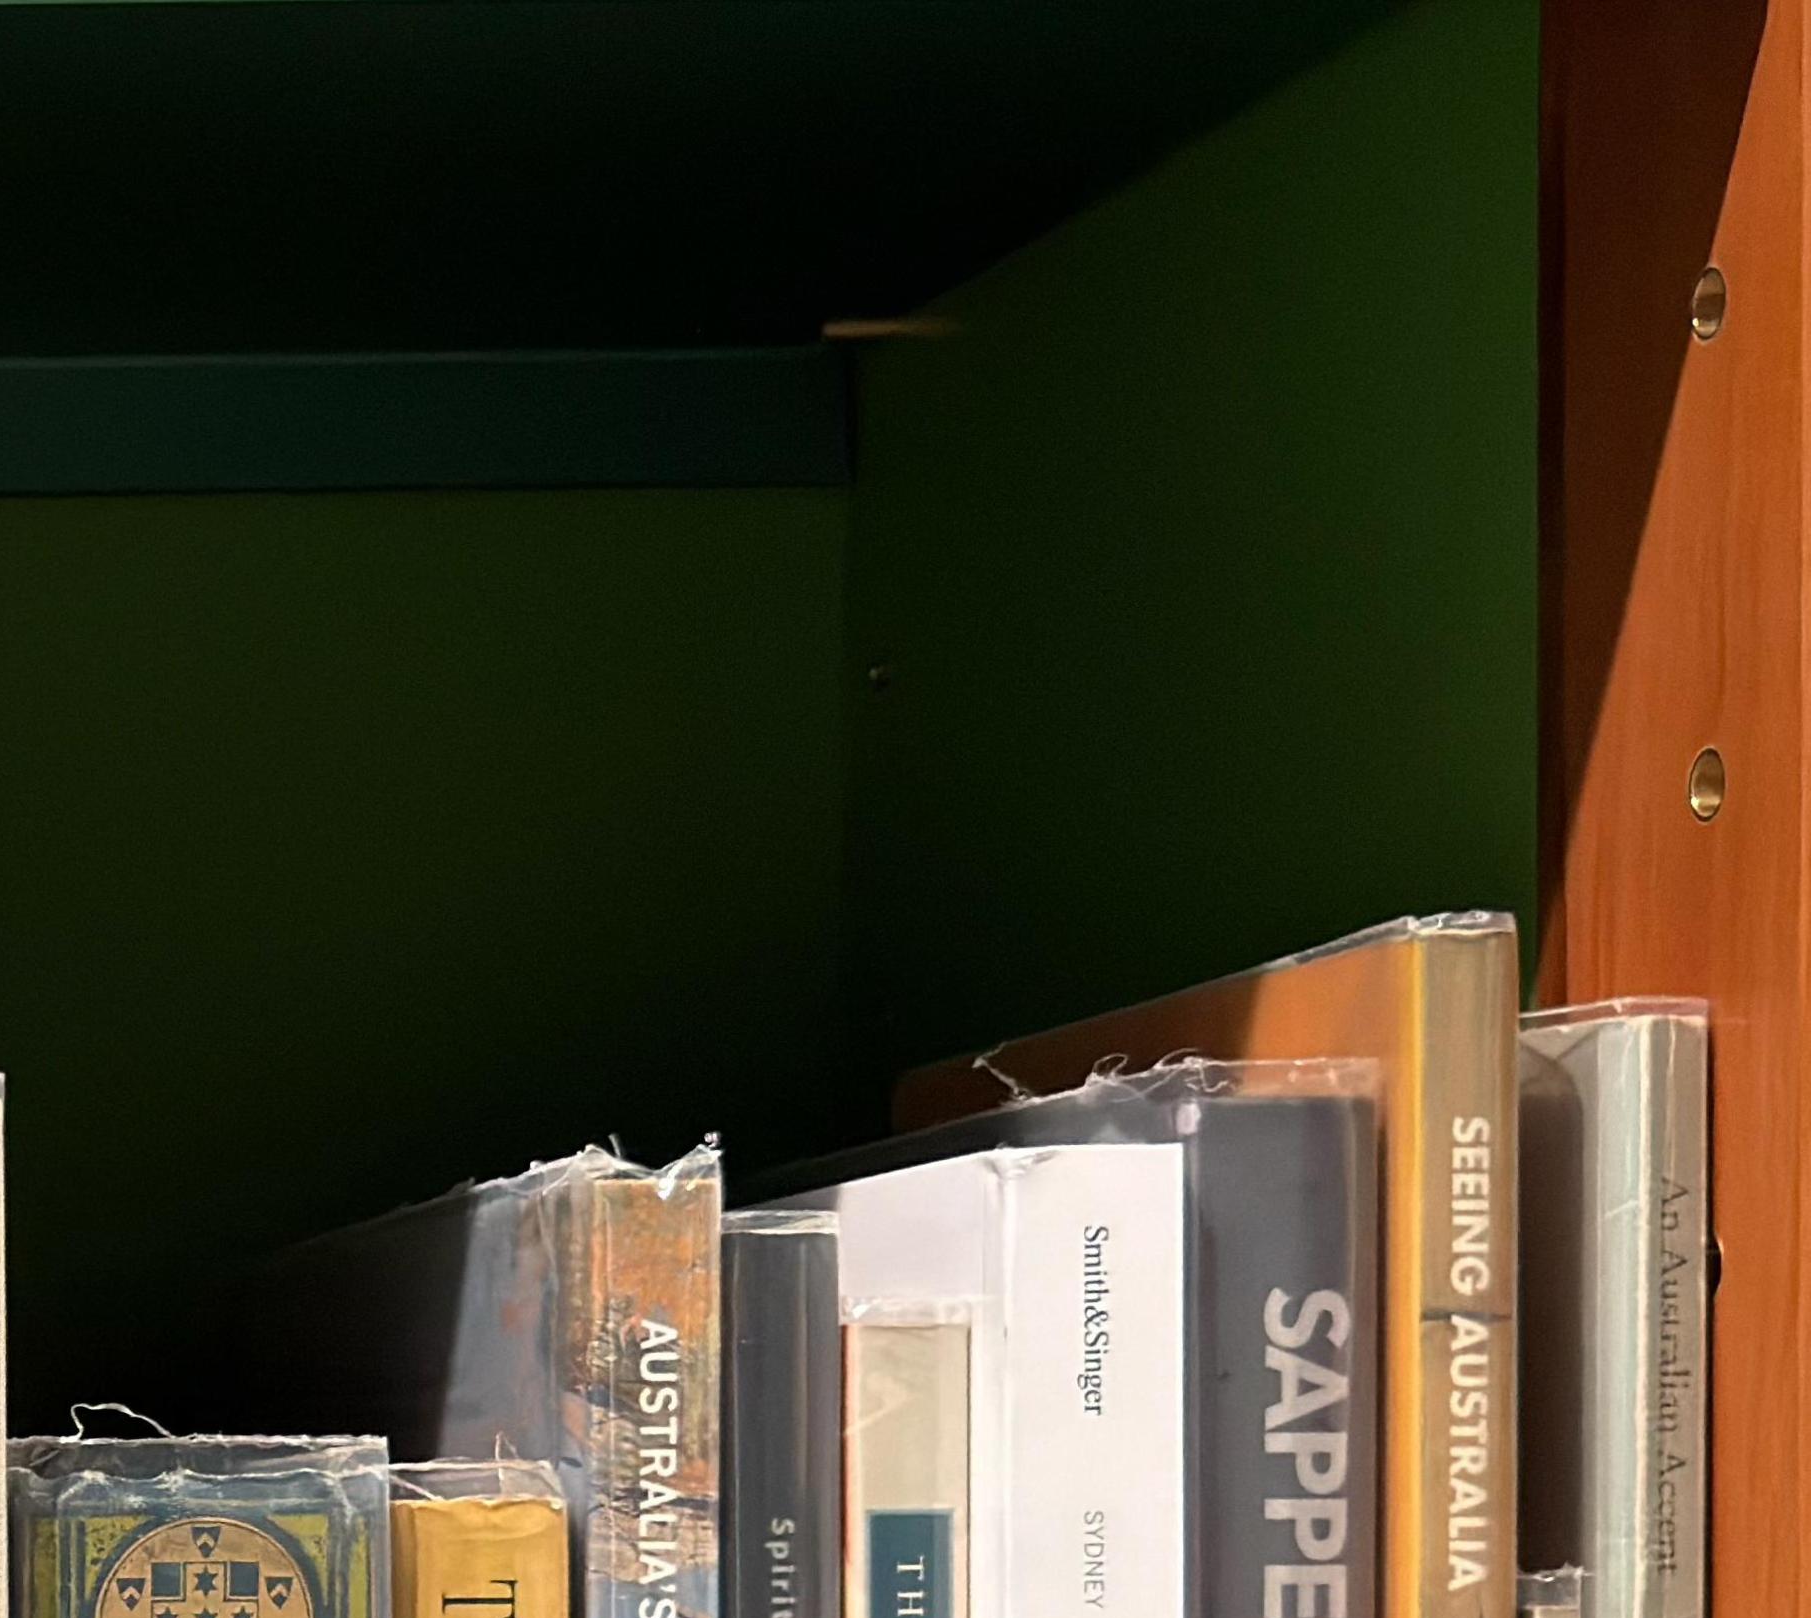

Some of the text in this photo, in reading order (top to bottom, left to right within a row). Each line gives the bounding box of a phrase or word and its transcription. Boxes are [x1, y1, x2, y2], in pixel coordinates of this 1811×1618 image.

[1448, 1115, 1491, 1296] SEEING
[1447, 1314, 1491, 1593] AUSTRALIA
[1082, 1510, 1105, 1609] SYDNEY
